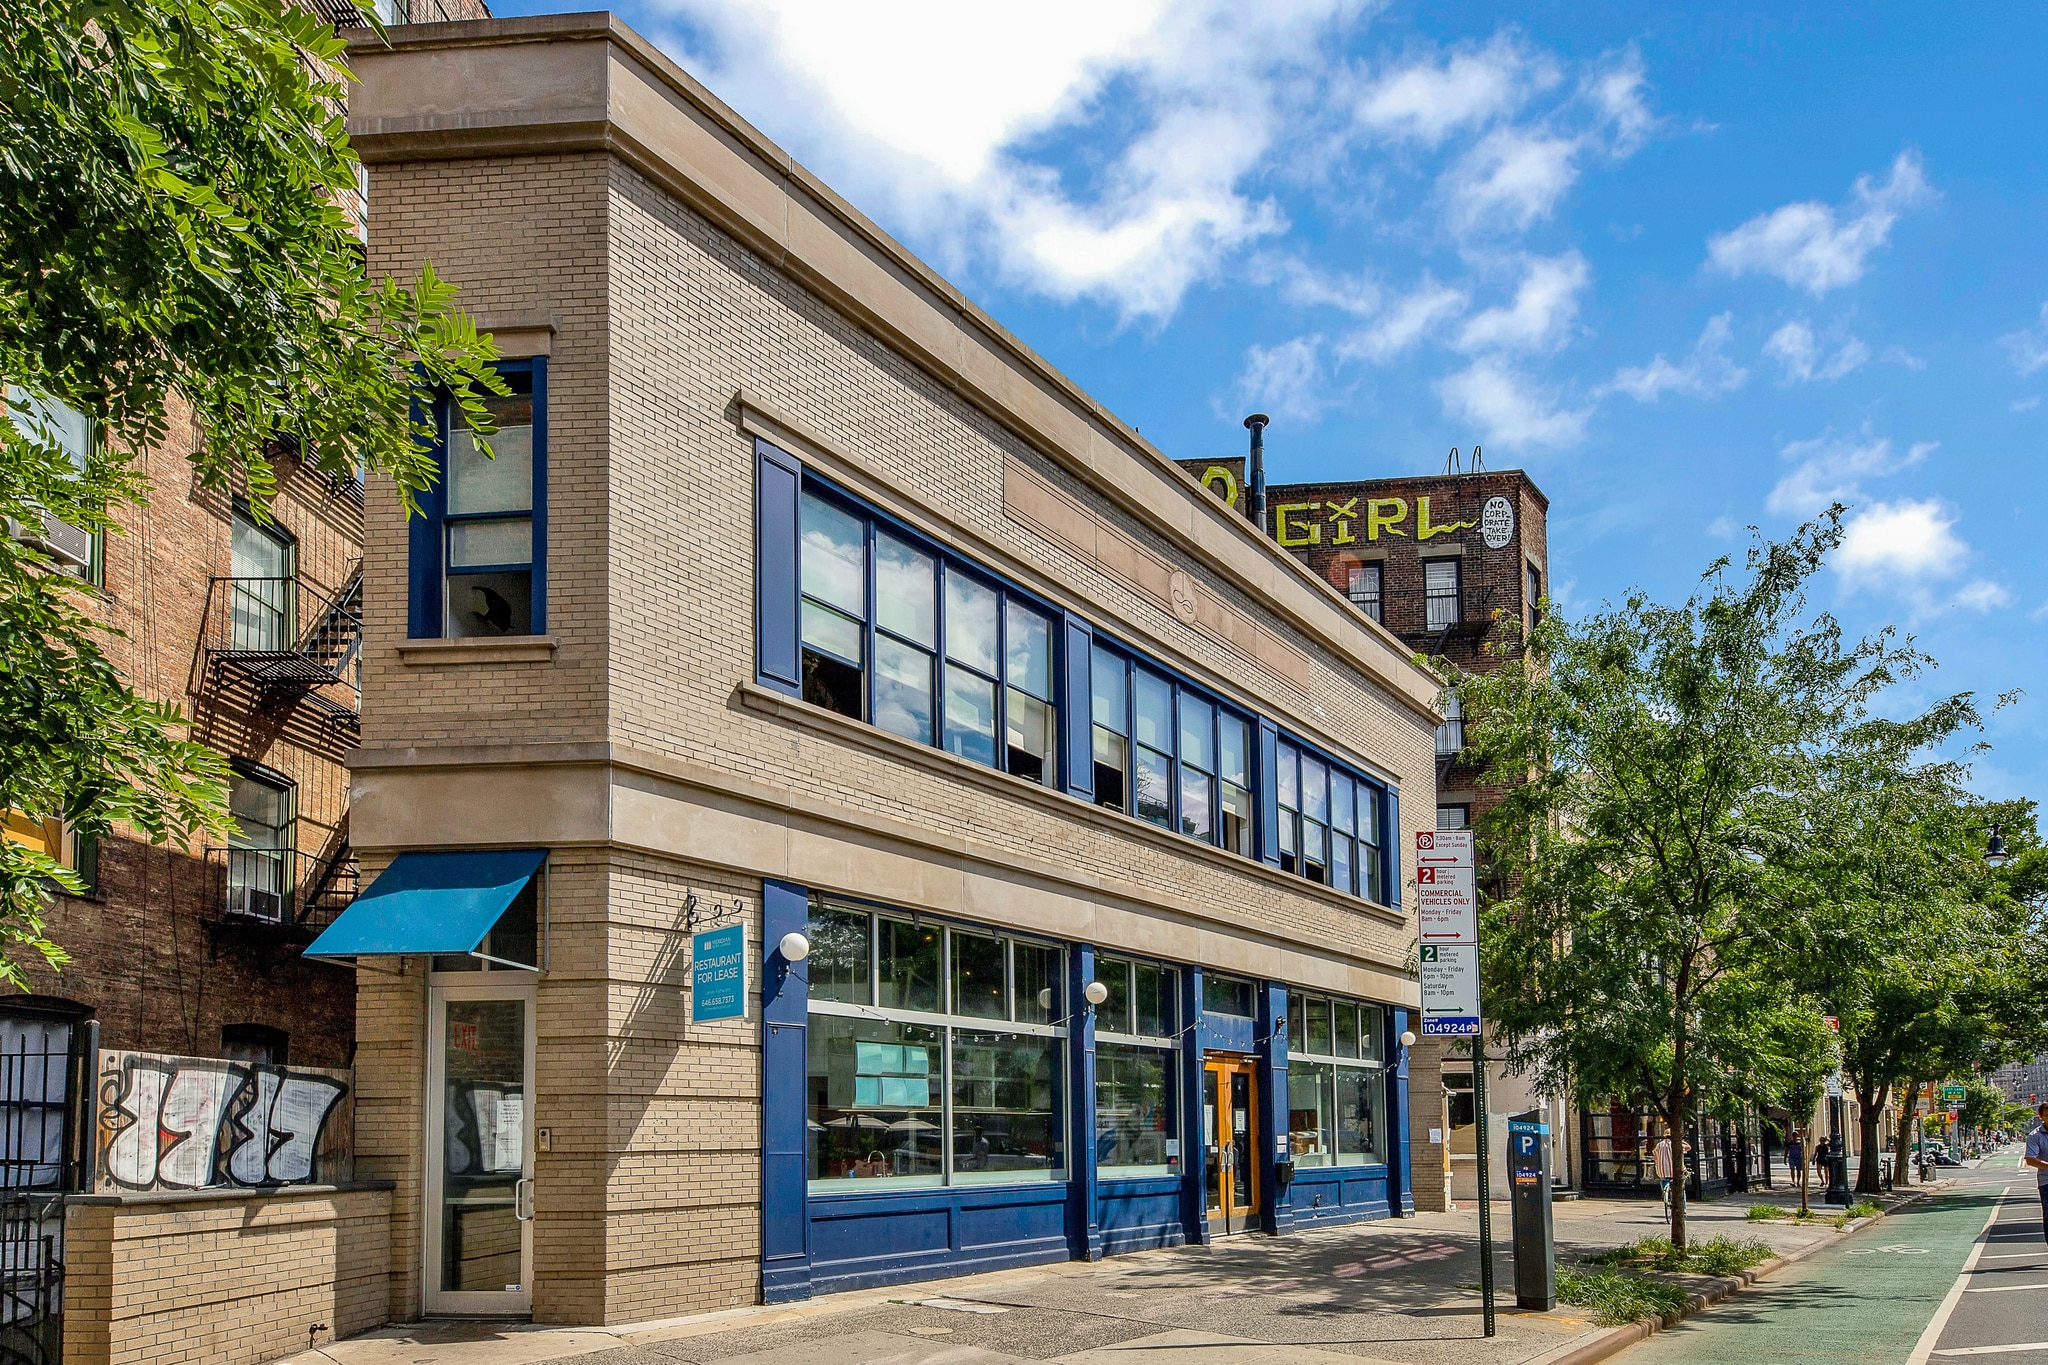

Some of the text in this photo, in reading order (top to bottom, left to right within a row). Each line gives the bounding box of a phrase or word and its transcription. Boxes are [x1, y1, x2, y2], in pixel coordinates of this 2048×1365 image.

[1490, 501, 1504, 509] NO
[1422, 869, 1432, 882] 2
[695, 952, 742, 971] RESTAURANT
[1424, 947, 1434, 961] 2
[697, 967, 738, 984] FOR LEASE
[1424, 1024, 1466, 1033] 104924
[454, 1024, 477, 1050] EXIT
[1522, 1136, 1533, 1153] P
